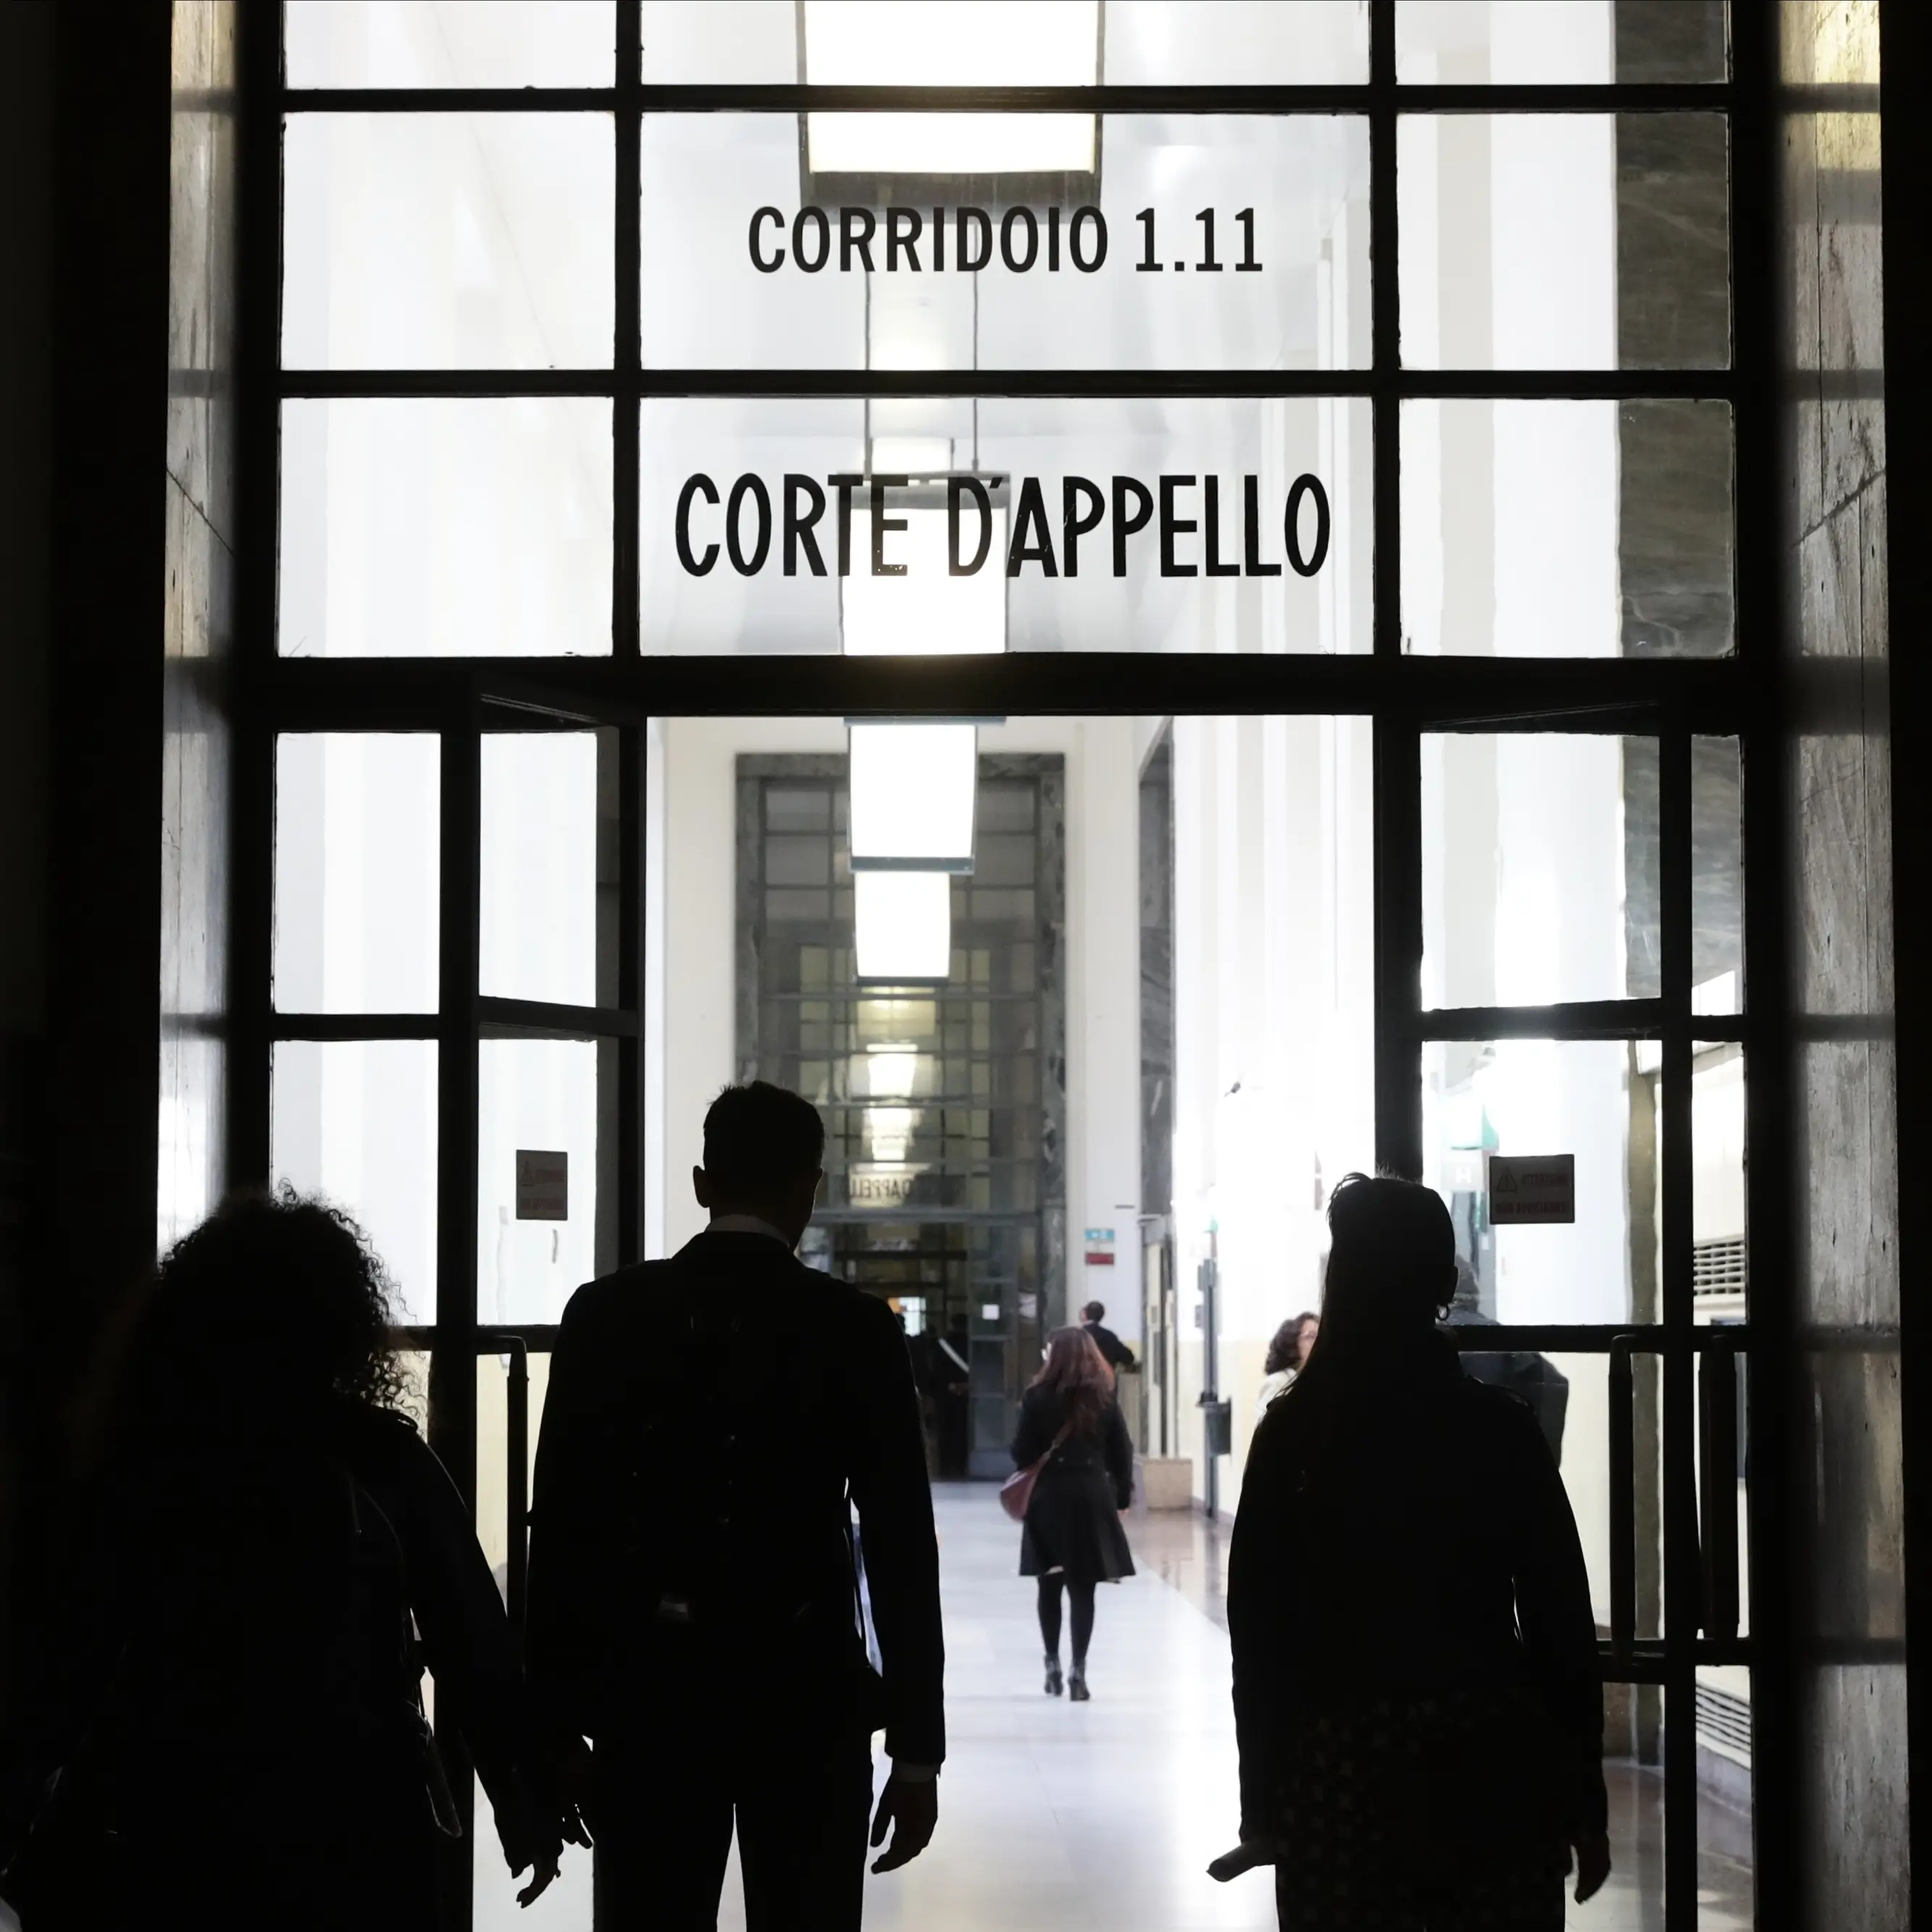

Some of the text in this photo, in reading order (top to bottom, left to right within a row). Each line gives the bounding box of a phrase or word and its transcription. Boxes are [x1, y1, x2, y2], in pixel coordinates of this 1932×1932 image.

[749, 206, 1263, 273] CORRIDOIO 1.11
[675, 473, 1330, 577] CORTE D'APPELLO
